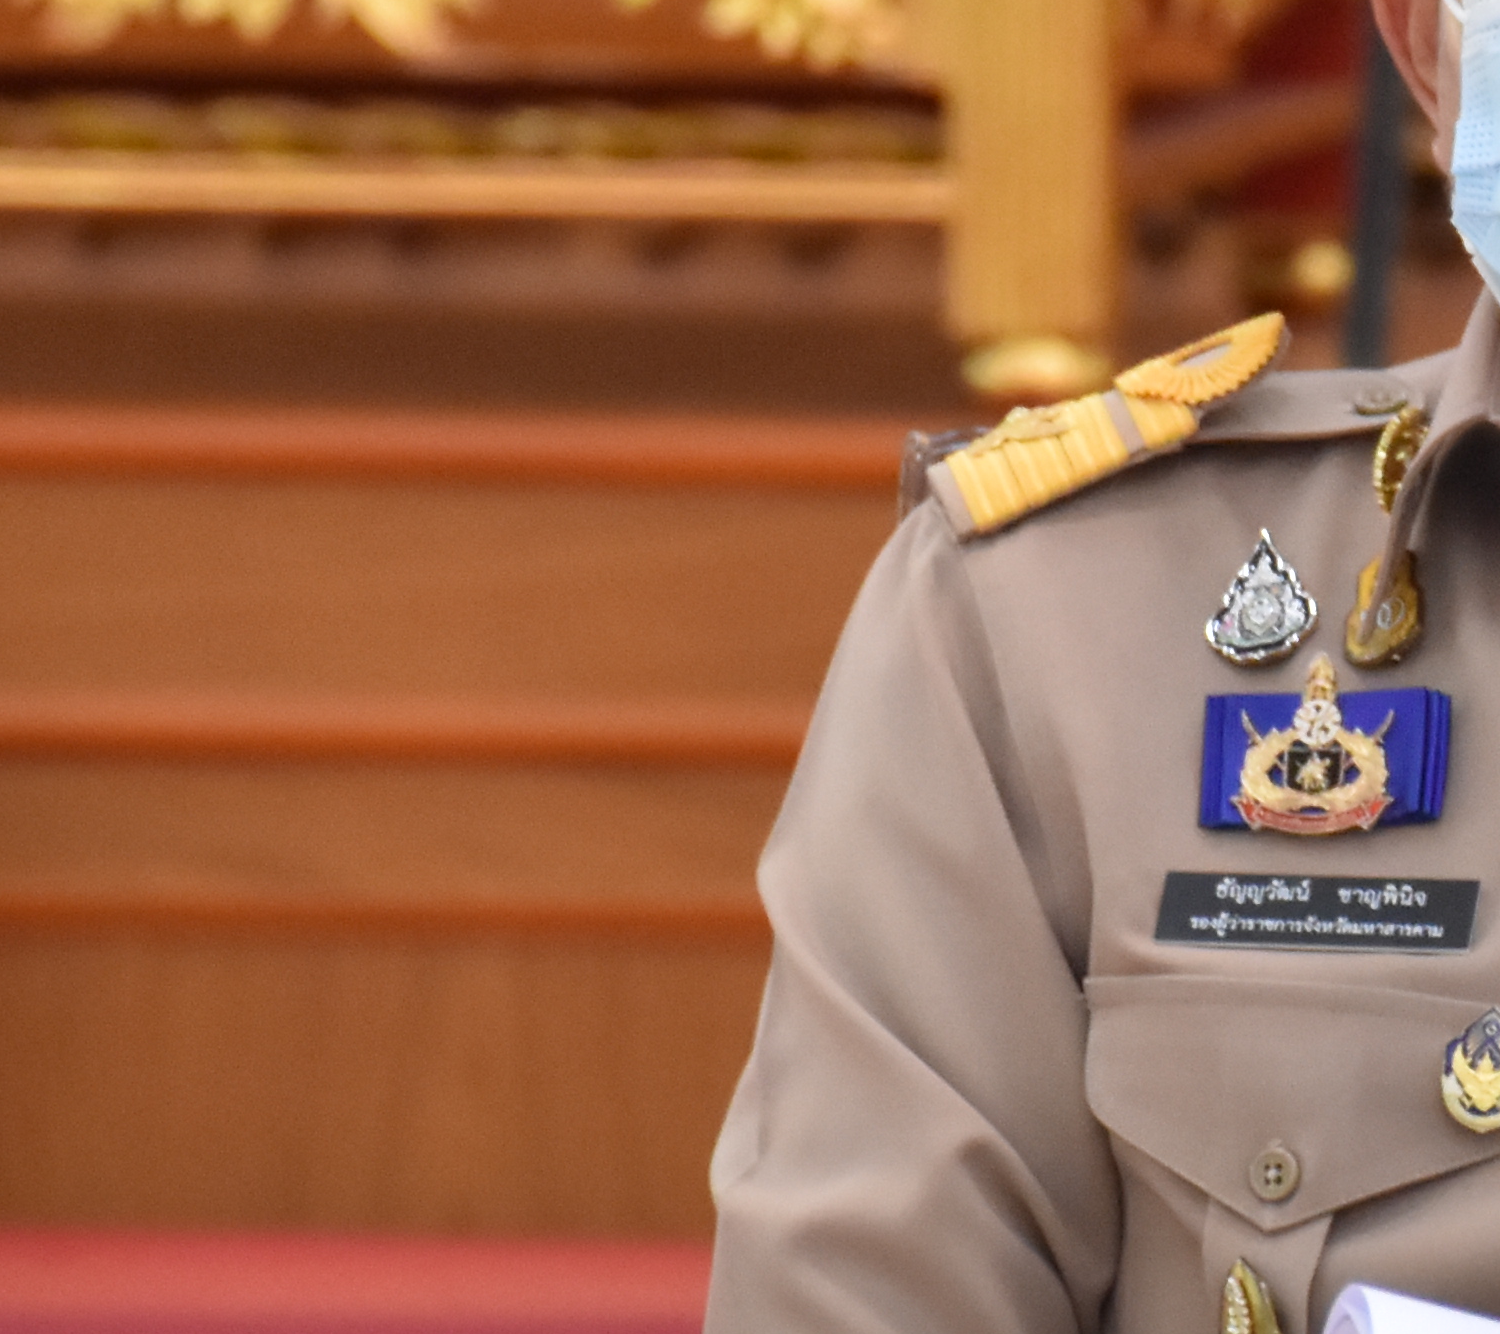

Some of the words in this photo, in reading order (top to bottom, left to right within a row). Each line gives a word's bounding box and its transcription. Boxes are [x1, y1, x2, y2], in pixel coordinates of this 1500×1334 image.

[1215, 877, 1311, 905] ธัญญวัฒน์
[1337, 882, 1428, 911] ชาญพินิจ
